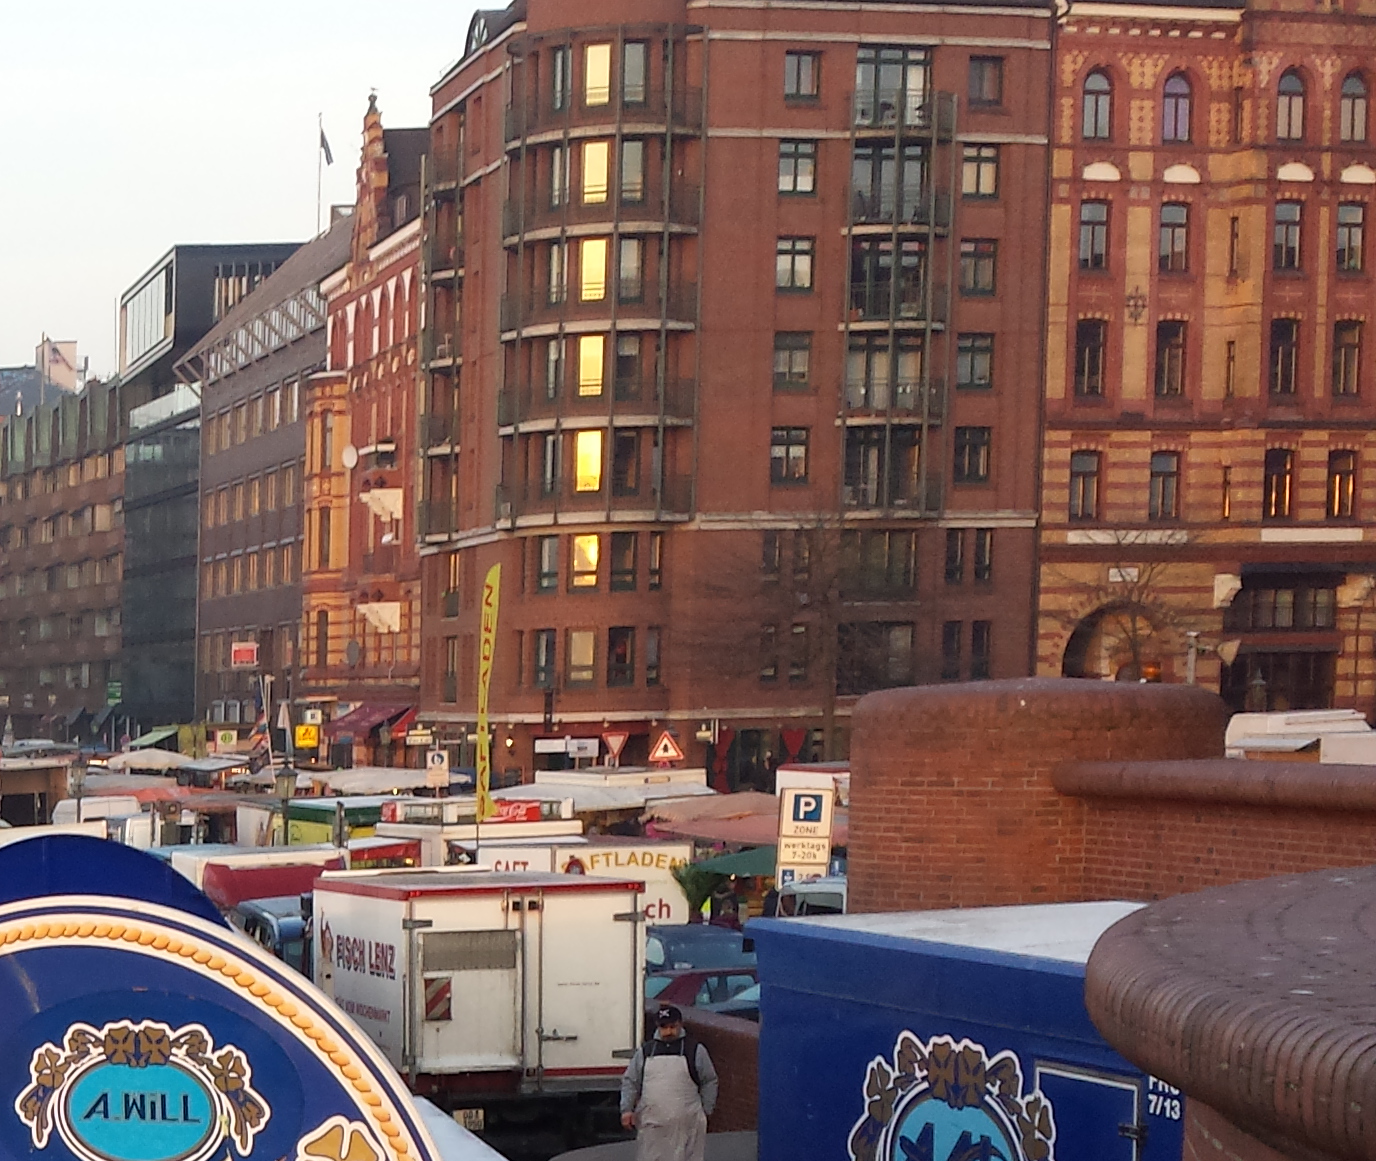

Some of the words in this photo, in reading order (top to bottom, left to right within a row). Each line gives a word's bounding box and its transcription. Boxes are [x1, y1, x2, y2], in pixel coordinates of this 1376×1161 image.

[794, 826, 818, 834] ZONE
[784, 842, 826, 852] werktags
[336, 934, 366, 974] FISCH
[369, 940, 396, 980] LENZ
[1148, 1093, 1181, 1120] 7/13
